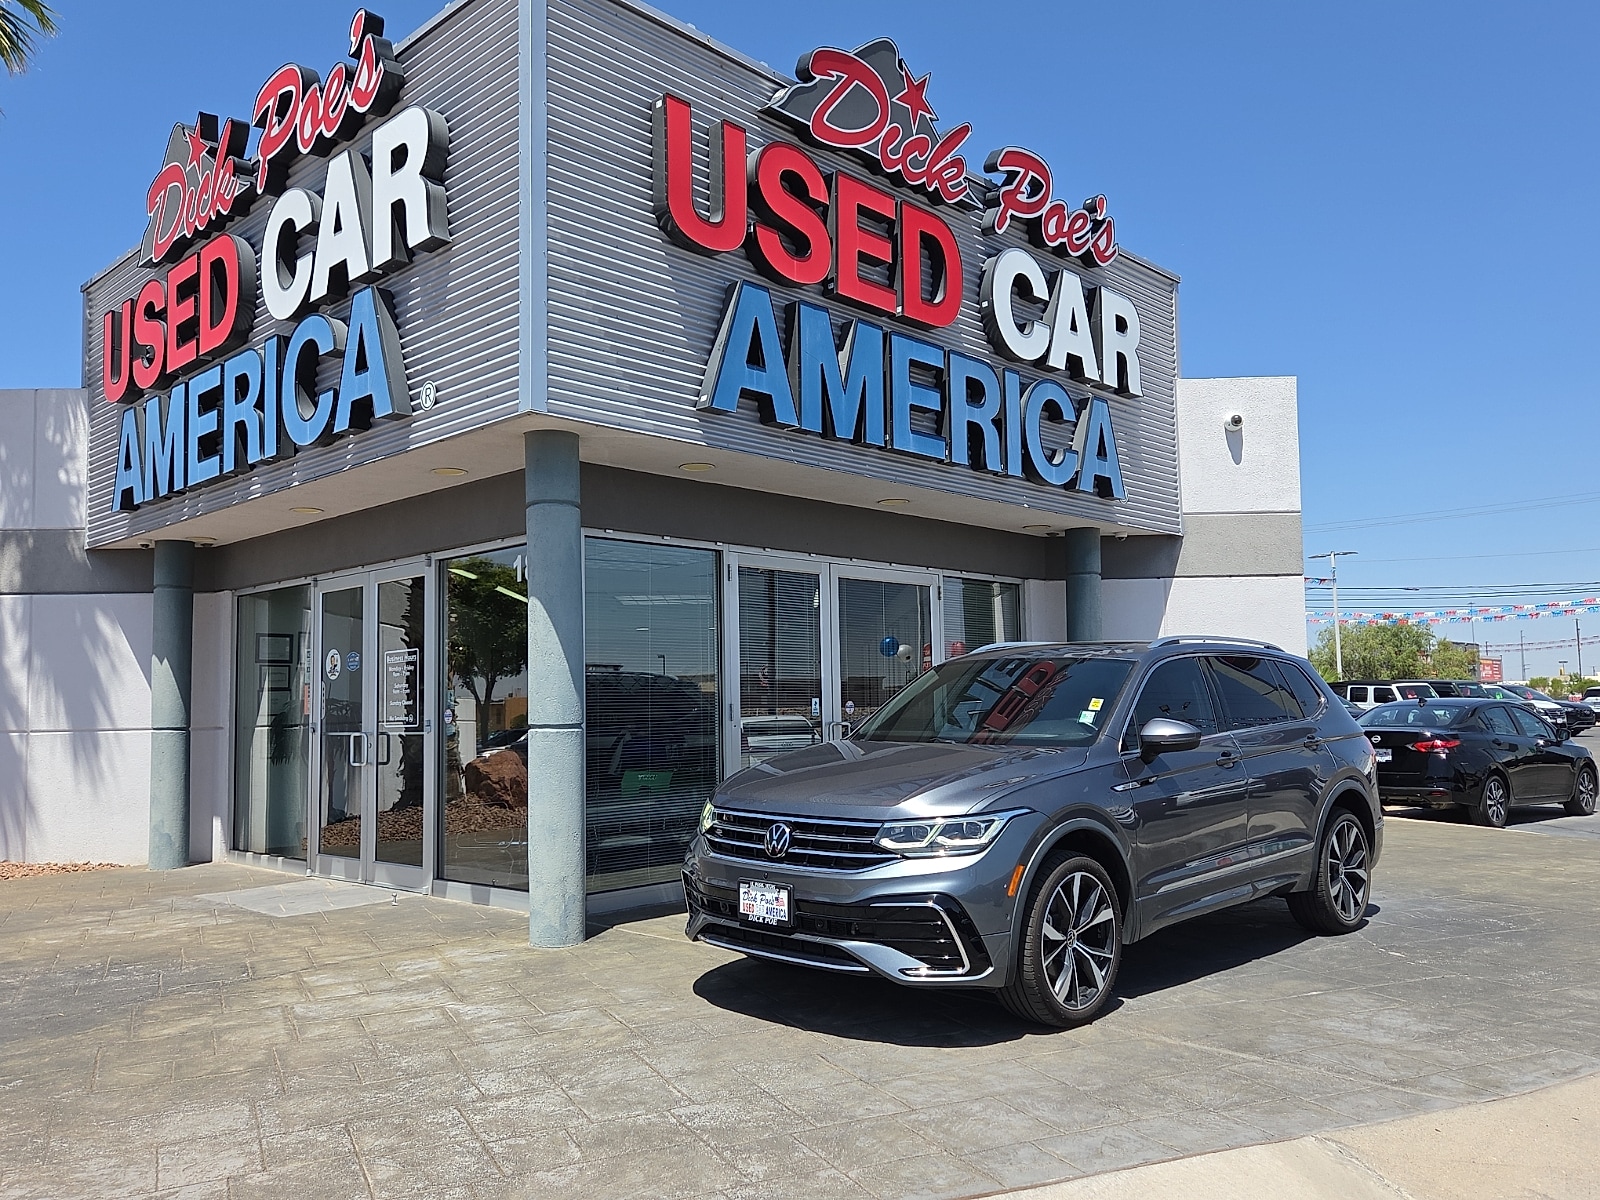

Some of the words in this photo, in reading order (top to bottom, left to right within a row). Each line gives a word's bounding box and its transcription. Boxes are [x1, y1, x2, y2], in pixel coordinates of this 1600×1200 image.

[146, 116, 239, 263] Dick
[252, 8, 386, 195] Poe's
[663, 93, 964, 329] USED
[992, 247, 1144, 398] CAR
[808, 46, 973, 203] Dick
[995, 145, 1119, 268] Poe's
[103, 233, 240, 404] USED
[261, 104, 434, 322] CAR
[111, 285, 395, 513] AMERICA
[707, 279, 1125, 499] AMERICA
[742, 902, 754, 913] USED
[766, 906, 786, 919] AMERICA
[743, 891, 757, 903] Dick
[748, 914, 763, 923] DICK
[765, 916, 777, 925] POE
